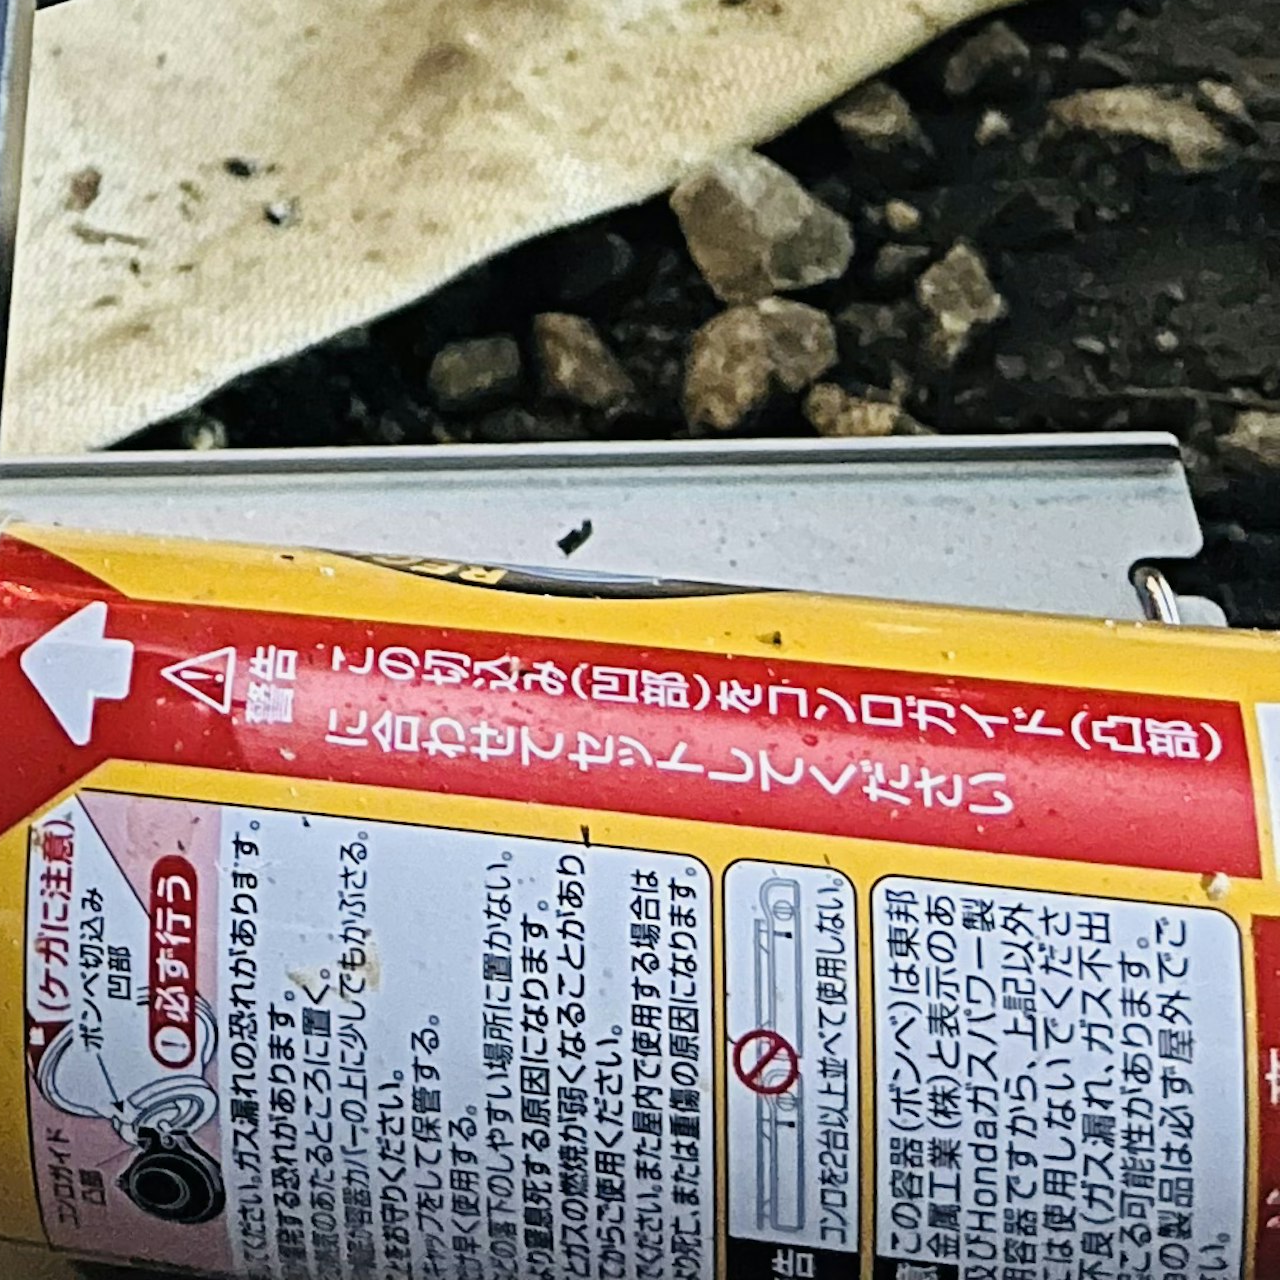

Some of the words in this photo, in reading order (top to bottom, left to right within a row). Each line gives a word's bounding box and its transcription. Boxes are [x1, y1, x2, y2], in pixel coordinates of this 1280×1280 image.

[244, 644, 299, 725] 警告
[325, 708, 1014, 817] に合わせてセットしてください
[331, 645, 1222, 762] この切込み(凹部)をコンロガイド(凸部)
[37, 818, 75, 1012] (ケガに注意)
[77, 887, 105, 1051] ボンベ切込み
[106, 946, 132, 1001] 凹部
[154, 874, 193, 1022] 必ず行う
[230, 820, 272, 1280] してください。ガス漏れの恐れがあります。
[556, 854, 590, 1280] とガスの燃焼が弱くなることがあり
[816, 878, 850, 1244] コンロを2台以上並べて使用しない。
[885, 889, 923, 1255] この容器(ボンベ)は東邦
[926, 896, 962, 1260] 金属工業(株)と表示のあ
[45, 1127, 77, 1229] コンロガイド
[79, 1170, 105, 1207] 凸部
[412, 1014, 450, 1280] キャップをして保管する。
[593, 1024, 626, 1279] てからご使用ください。
[772, 1248, 815, 1280] 告
[1198, 1233, 1231, 1280] い。
